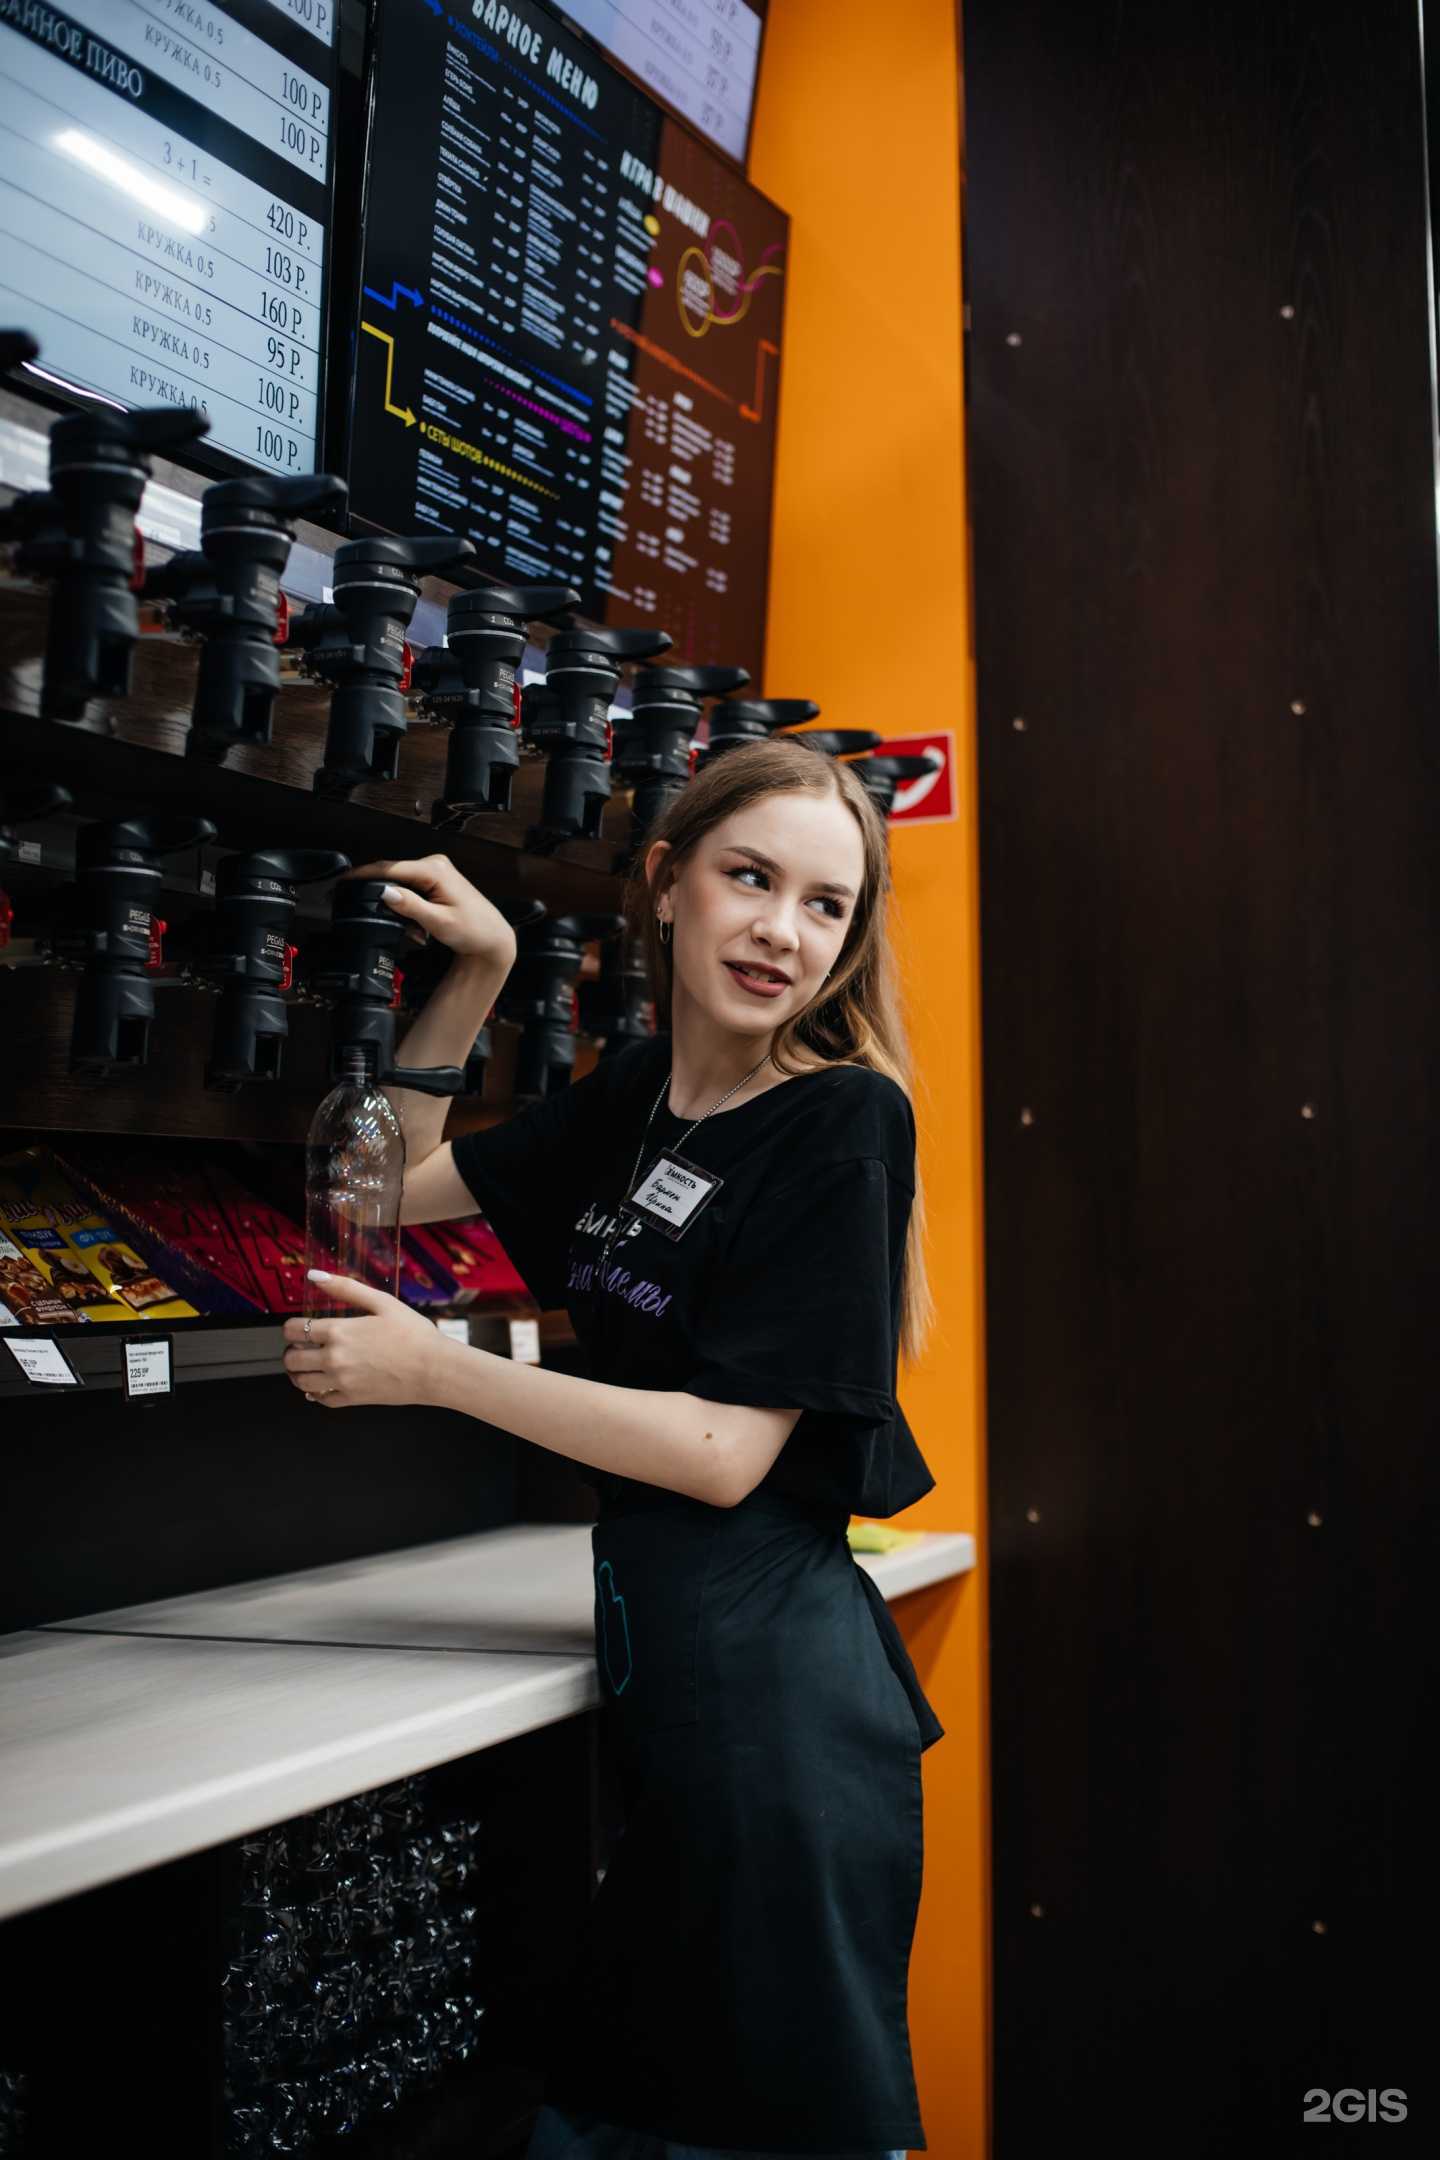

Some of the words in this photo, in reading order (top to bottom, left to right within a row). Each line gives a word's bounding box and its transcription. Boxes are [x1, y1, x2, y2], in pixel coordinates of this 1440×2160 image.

[86, 39, 143, 97] ПИВО
[145, 24, 201, 75] КРУЖКА
[204, 65, 221, 89] 0.5
[280, 117, 306, 155] 100
[282, 72, 308, 111] 100
[546, 46, 599, 111] МЕНЮ
[266, 202, 294, 238] 420
[137, 221, 193, 268] КРУЖКА
[197, 255, 215, 279] 0.5
[261, 291, 288, 328] 160
[265, 247, 291, 284] 103
[135, 270, 191, 316] КРУЖКА
[194, 303, 212, 326] 0.5
[267, 336, 285, 369] 95
[133, 316, 189, 360] КРУЖКА
[193, 347, 210, 369] 0.5
[258, 377, 284, 414] 100
[130, 365, 187, 408] КРУЖКА
[256, 426, 283, 461] 100
